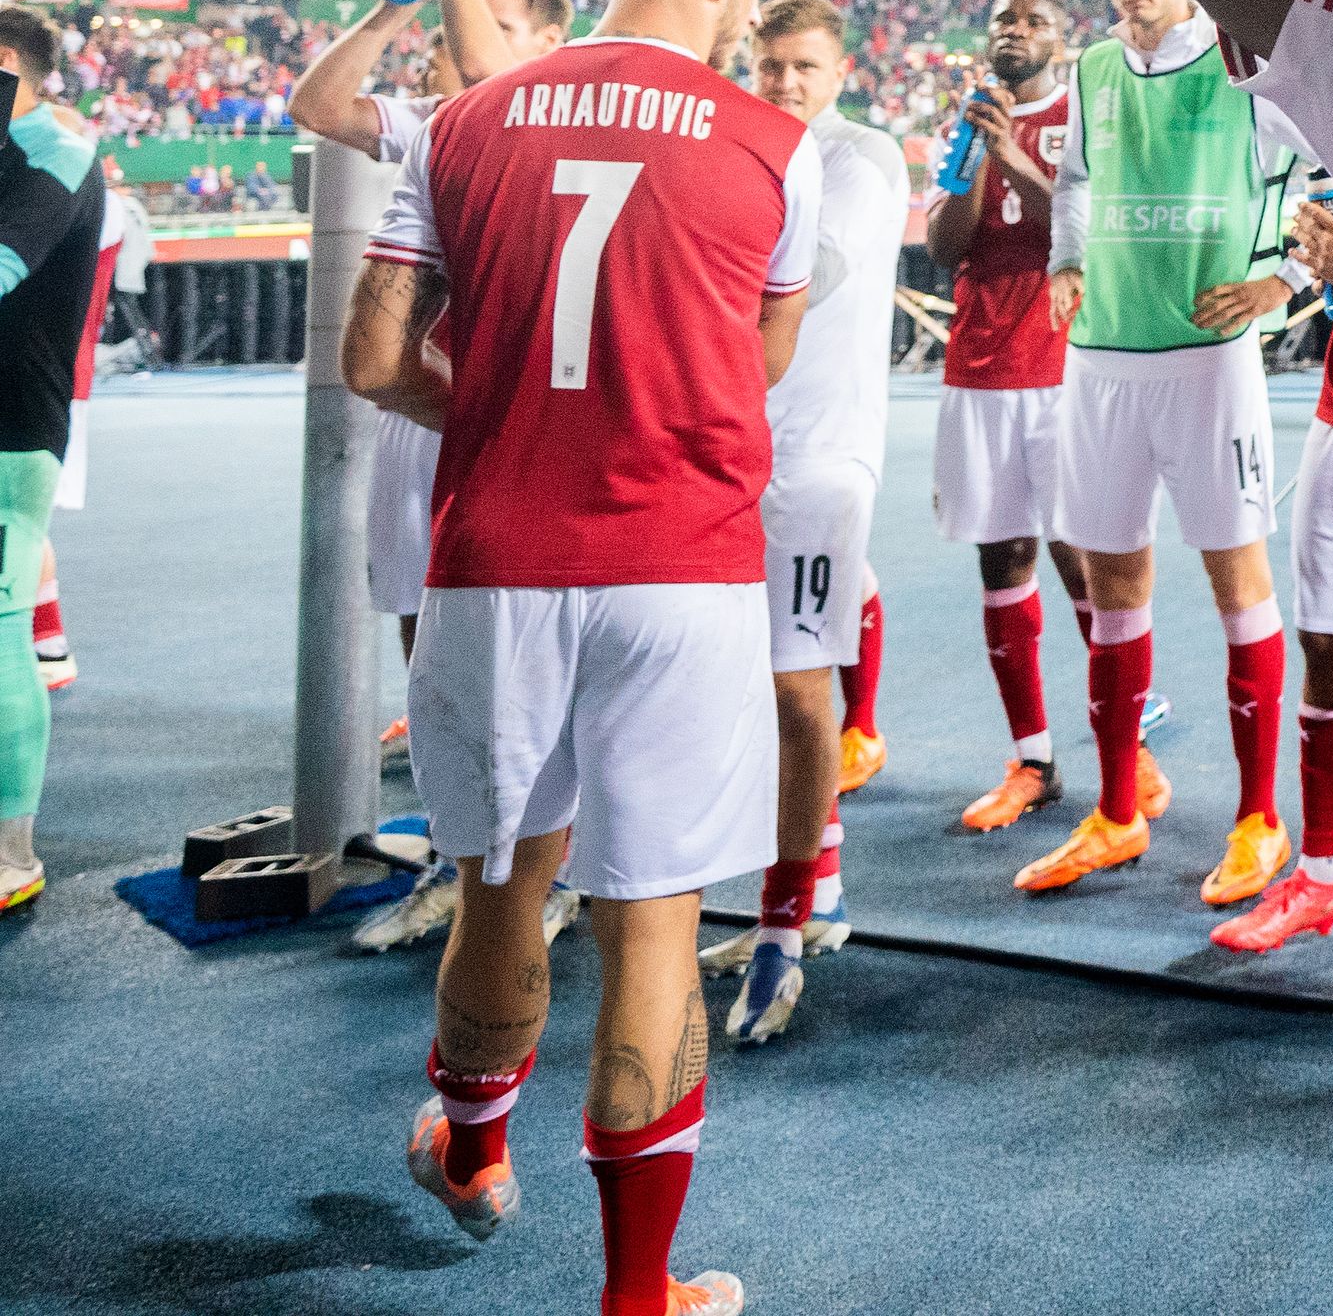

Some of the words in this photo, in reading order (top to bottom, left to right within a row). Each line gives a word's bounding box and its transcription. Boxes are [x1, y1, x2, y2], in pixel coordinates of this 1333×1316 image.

[504, 82, 716, 140] ARNAUTOVIC
[1104, 204, 1228, 234] RESPECT
[551, 159, 644, 390] 7
[1232, 436, 1265, 491] 14
[791, 554, 832, 615] 19
